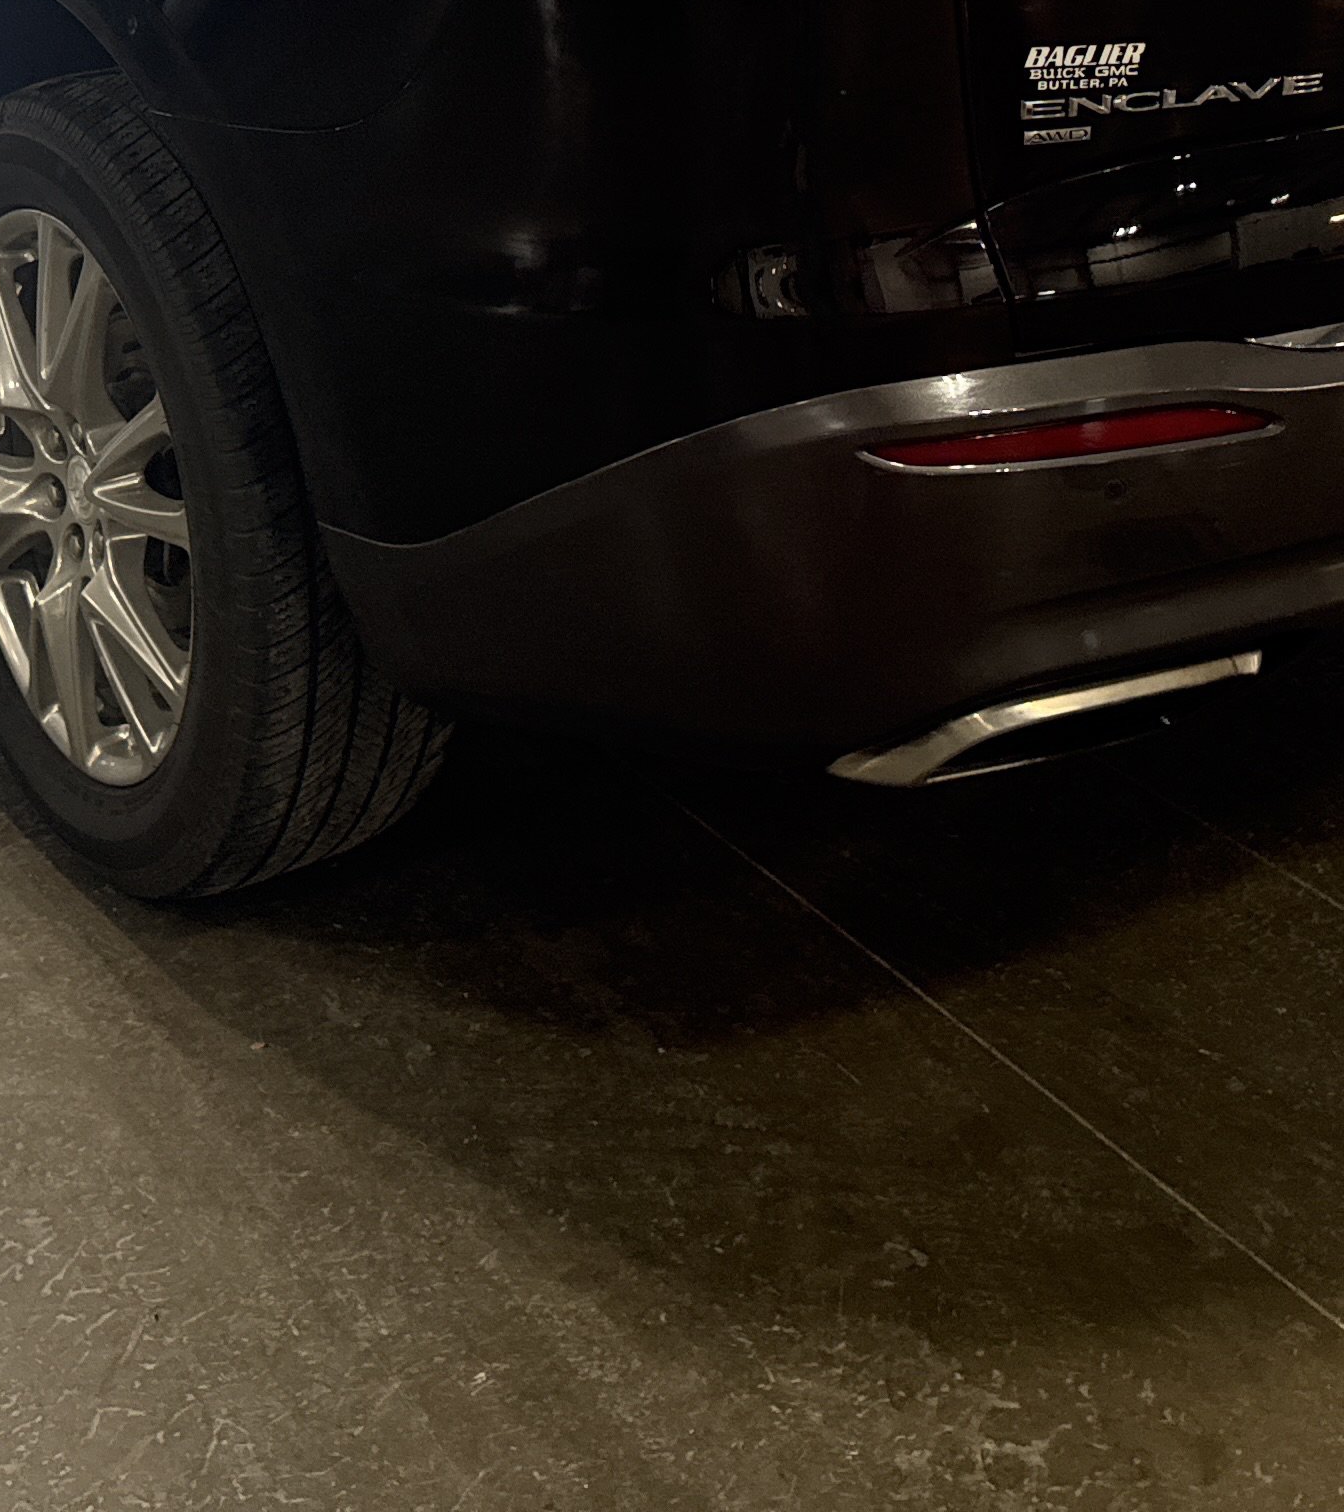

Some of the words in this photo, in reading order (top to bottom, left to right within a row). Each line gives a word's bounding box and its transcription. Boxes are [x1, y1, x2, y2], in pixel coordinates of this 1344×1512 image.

[1024, 42, 1146, 68] BAGLIER
[1029, 66, 1086, 80] BUICK
[1094, 64, 1139, 77] GMC
[1109, 77, 1128, 88] PA
[1020, 72, 1324, 120] ENCLAVE
[1024, 128, 1089, 143] AWD
